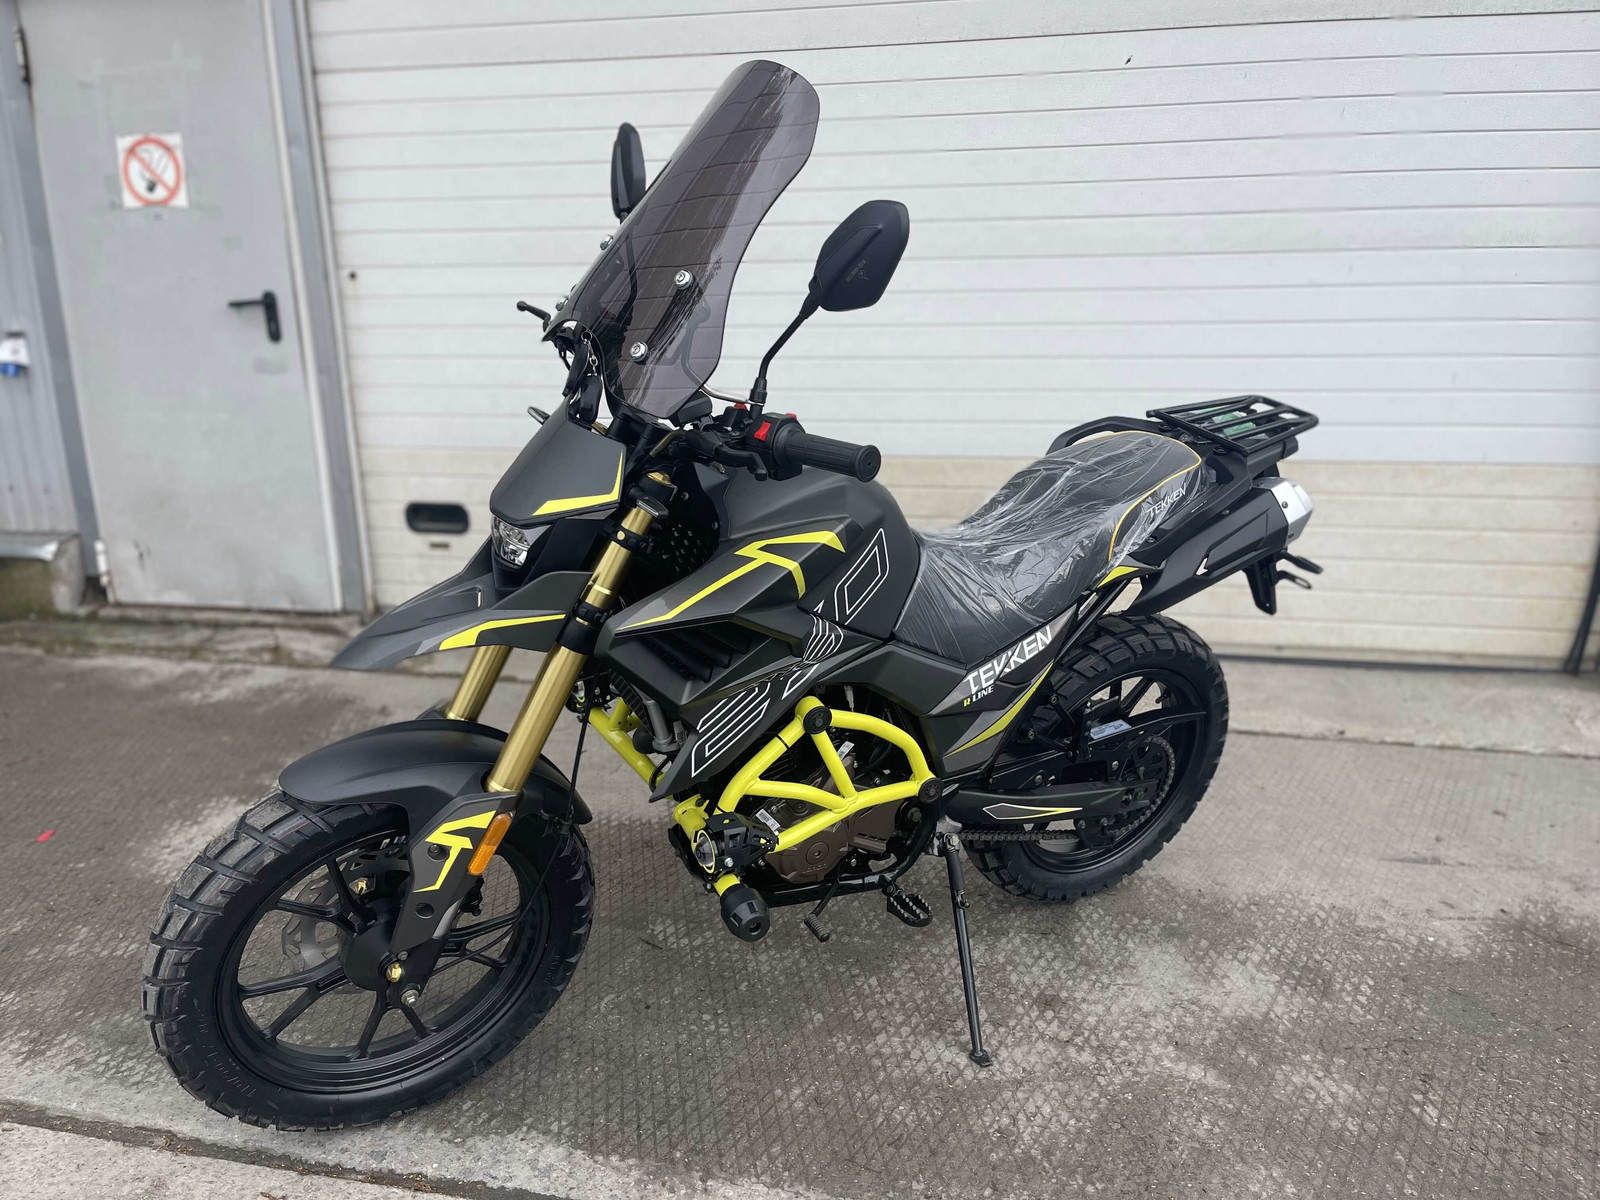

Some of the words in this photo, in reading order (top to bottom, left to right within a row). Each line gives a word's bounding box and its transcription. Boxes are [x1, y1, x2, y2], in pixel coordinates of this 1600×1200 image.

[1146, 483, 1187, 517] TEKKEN
[963, 626, 1052, 694] TEKKEN
[963, 698, 971, 707] R
[972, 685, 994, 702] LINE
